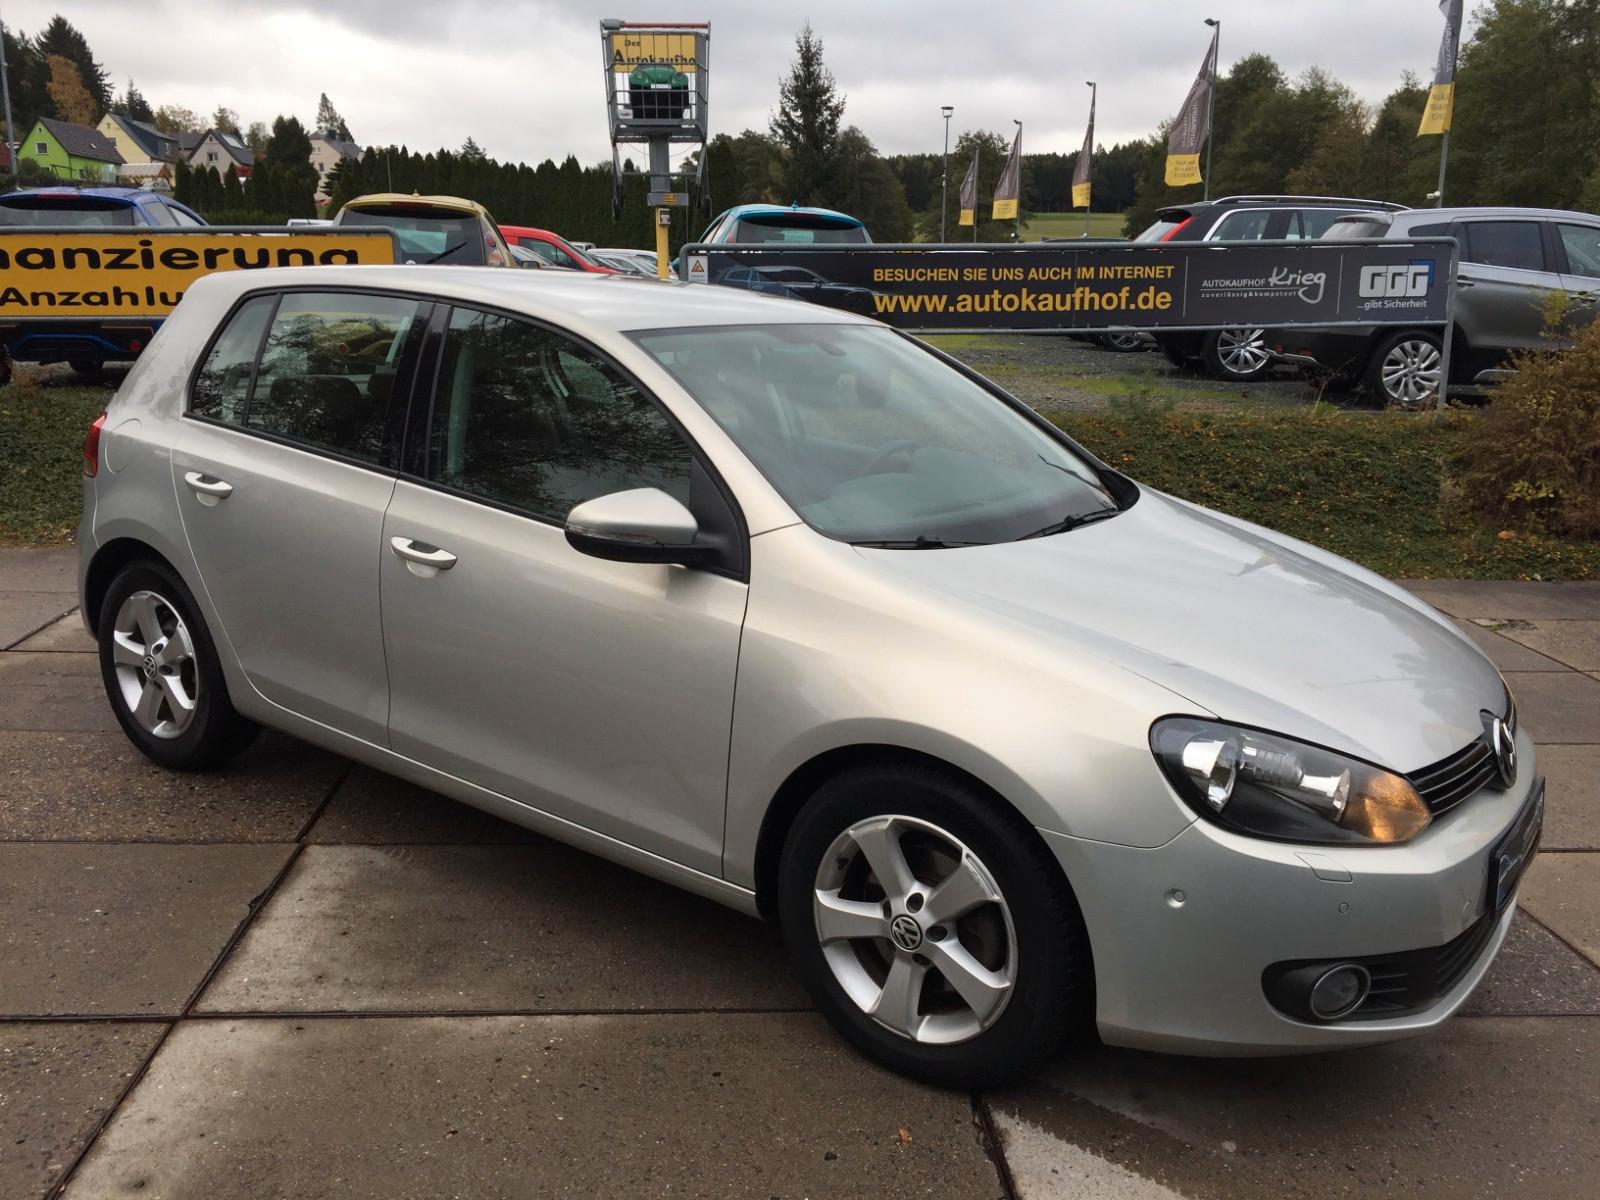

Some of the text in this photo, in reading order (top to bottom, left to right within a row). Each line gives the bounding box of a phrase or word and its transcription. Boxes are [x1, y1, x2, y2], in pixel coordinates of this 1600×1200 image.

[873, 265, 1175, 282] BESUCHEN SIE UNS AUCH IM INTERNET
[1202, 266, 1327, 304] AUTOKAUFHOF Krieg
[874, 286, 1173, 313] www.autokaufhof.de
[1384, 299, 1427, 309] Sicherheit
